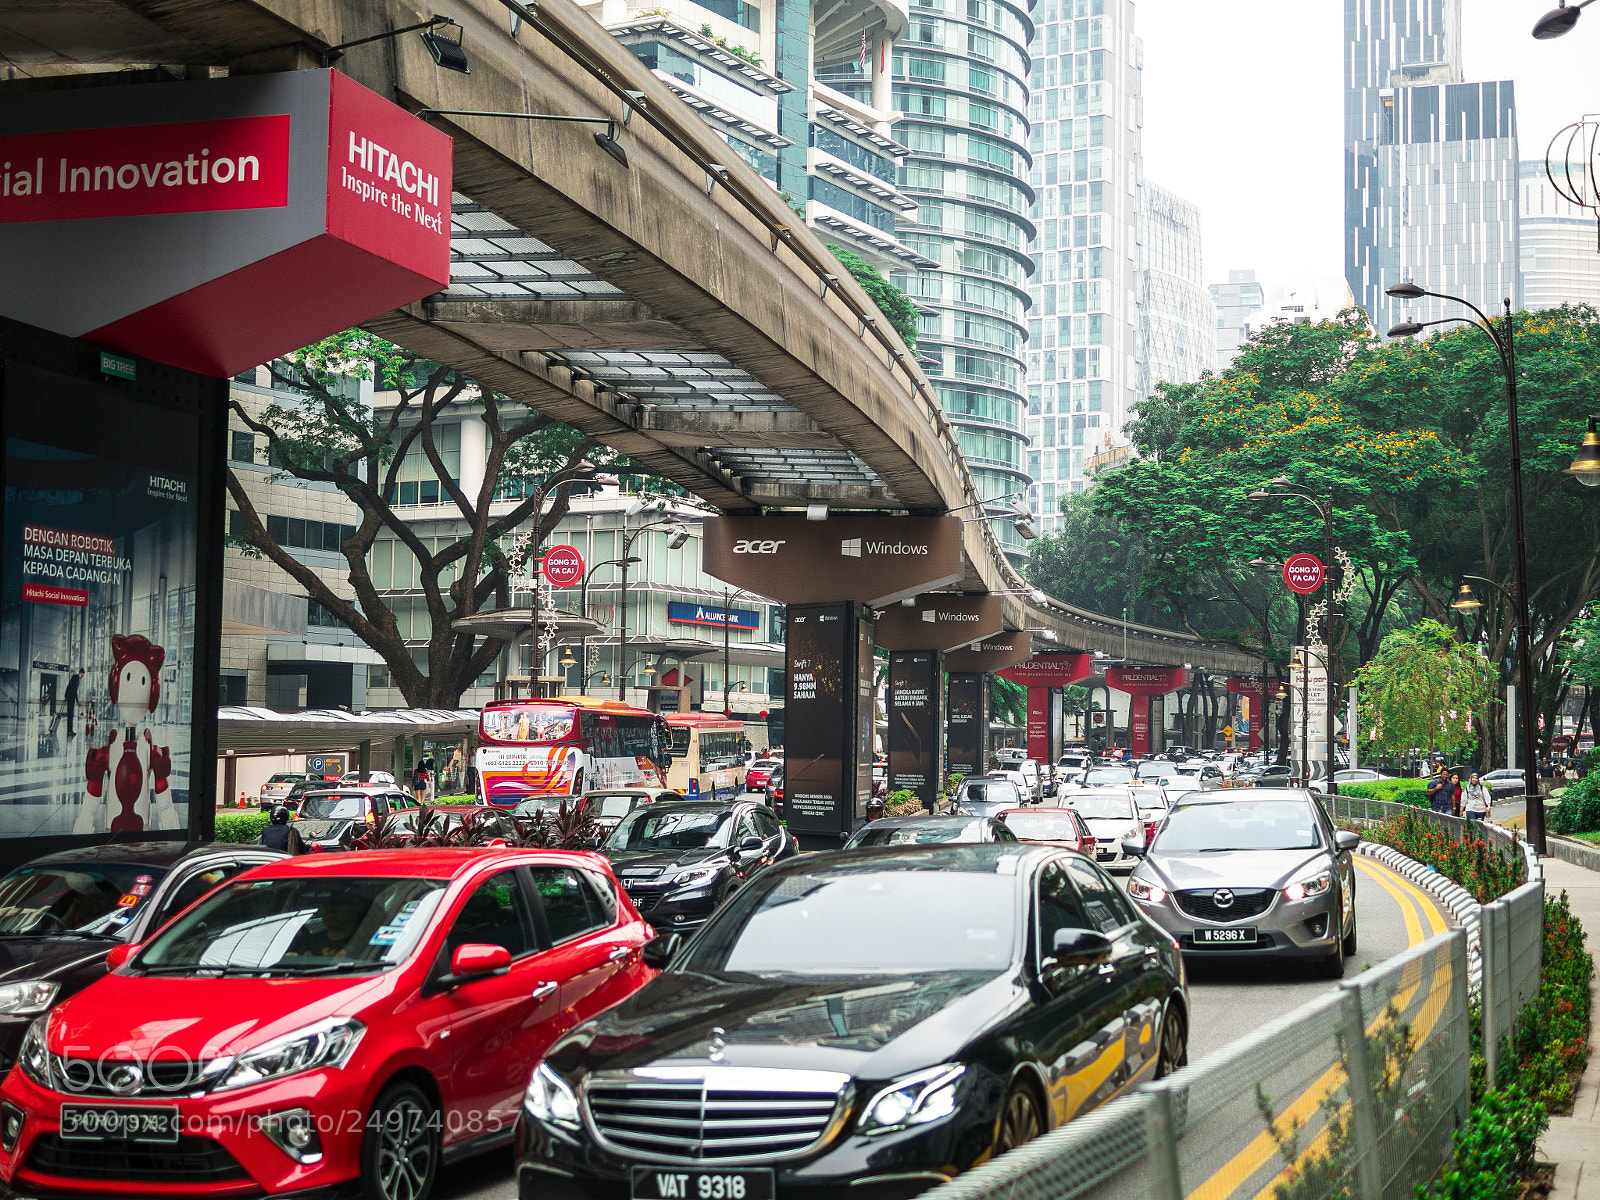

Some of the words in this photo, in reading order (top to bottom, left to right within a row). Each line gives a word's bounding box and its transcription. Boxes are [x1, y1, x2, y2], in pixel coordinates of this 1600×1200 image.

[0, 157, 44, 197] ial
[59, 148, 260, 193] Innovation
[348, 130, 439, 206] HITACHI
[341, 166, 388, 207] Inspire
[391, 192, 412, 219] the
[414, 201, 443, 235] Next
[150, 475, 186, 493] HITACHI
[24, 527, 69, 546] DENGAN
[71, 534, 115, 553] ROBOTIK,
[733, 540, 786, 554] acer
[866, 541, 928, 556] Windows
[24, 544, 53, 560] MASA
[56, 548, 89, 565] DEPAN
[90, 553, 132, 571] TERBUKA
[548, 558, 570, 566] GONG
[570, 558, 578, 566] XI
[23, 560, 64, 578] KEPADA
[66, 566, 121, 585] CADANGAN
[1292, 574, 1302, 582] FA
[1302, 574, 1315, 582] CAI
[26, 588, 45, 598] Hitachi
[45, 590, 60, 600] Social
[60, 592, 86, 602] Innovation
[705, 611, 726, 621] ALLIANCE
[727, 613, 739, 623] ANK
[938, 612, 980, 621] Windows
[982, 643, 1013, 651] Windows
[793, 659, 807, 670] Swift
[1014, 662, 1060, 670] PRUDENTIAL
[793, 673, 814, 682] HANYA
[793, 690, 816, 699] SAHAJA
[315, 760, 321, 768] P
[1204, 930, 1212, 940] W
[1213, 930, 1237, 940] 5296
[1238, 930, 1246, 940] X
[71, 1113, 126, 1128] PATRIOT
[656, 1173, 689, 1198] VAT
[698, 1174, 746, 1199] 9318
